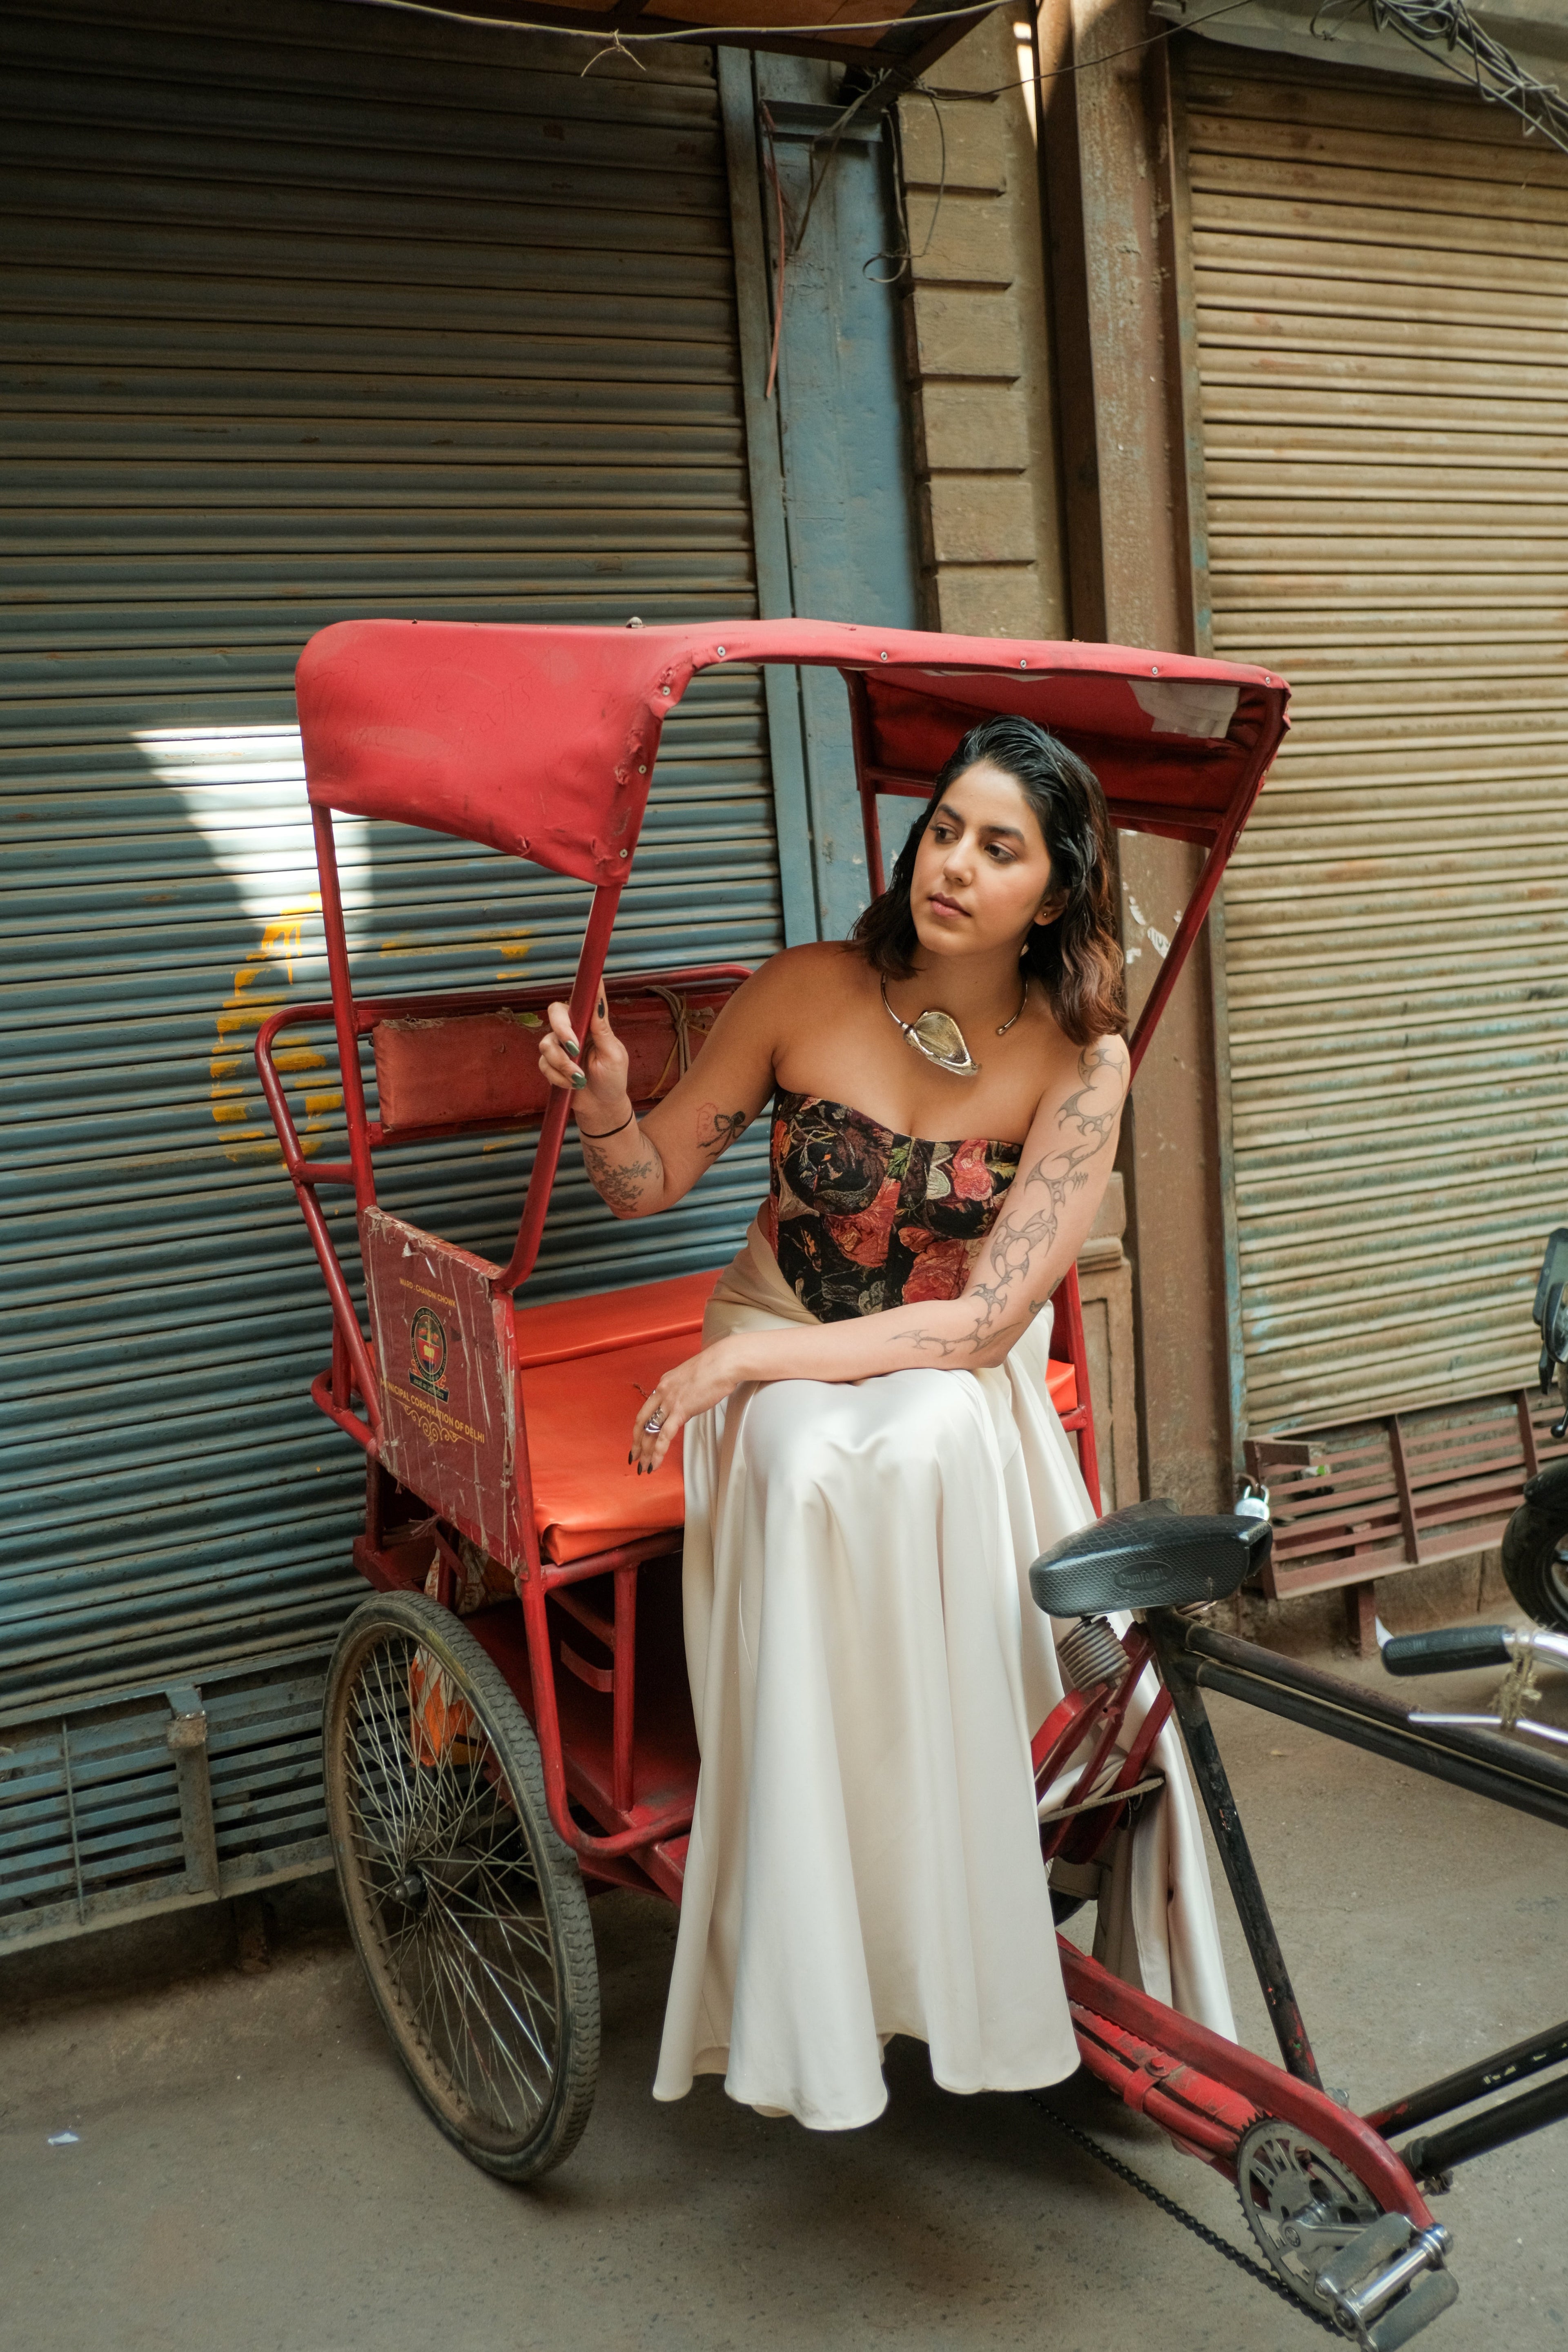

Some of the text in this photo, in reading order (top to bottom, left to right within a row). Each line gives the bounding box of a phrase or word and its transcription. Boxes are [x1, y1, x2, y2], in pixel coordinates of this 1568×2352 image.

[399, 1277, 413, 1289] WARD
[416, 1284, 437, 1299] CHANDNI
[437, 1294, 456, 1308] CHOWK
[380, 1377, 410, 1401] MUNICIPAL
[411, 1395, 454, 1427] CORPORATION
[455, 1420, 464, 1431] OF
[465, 1424, 485, 1444] DELHI
